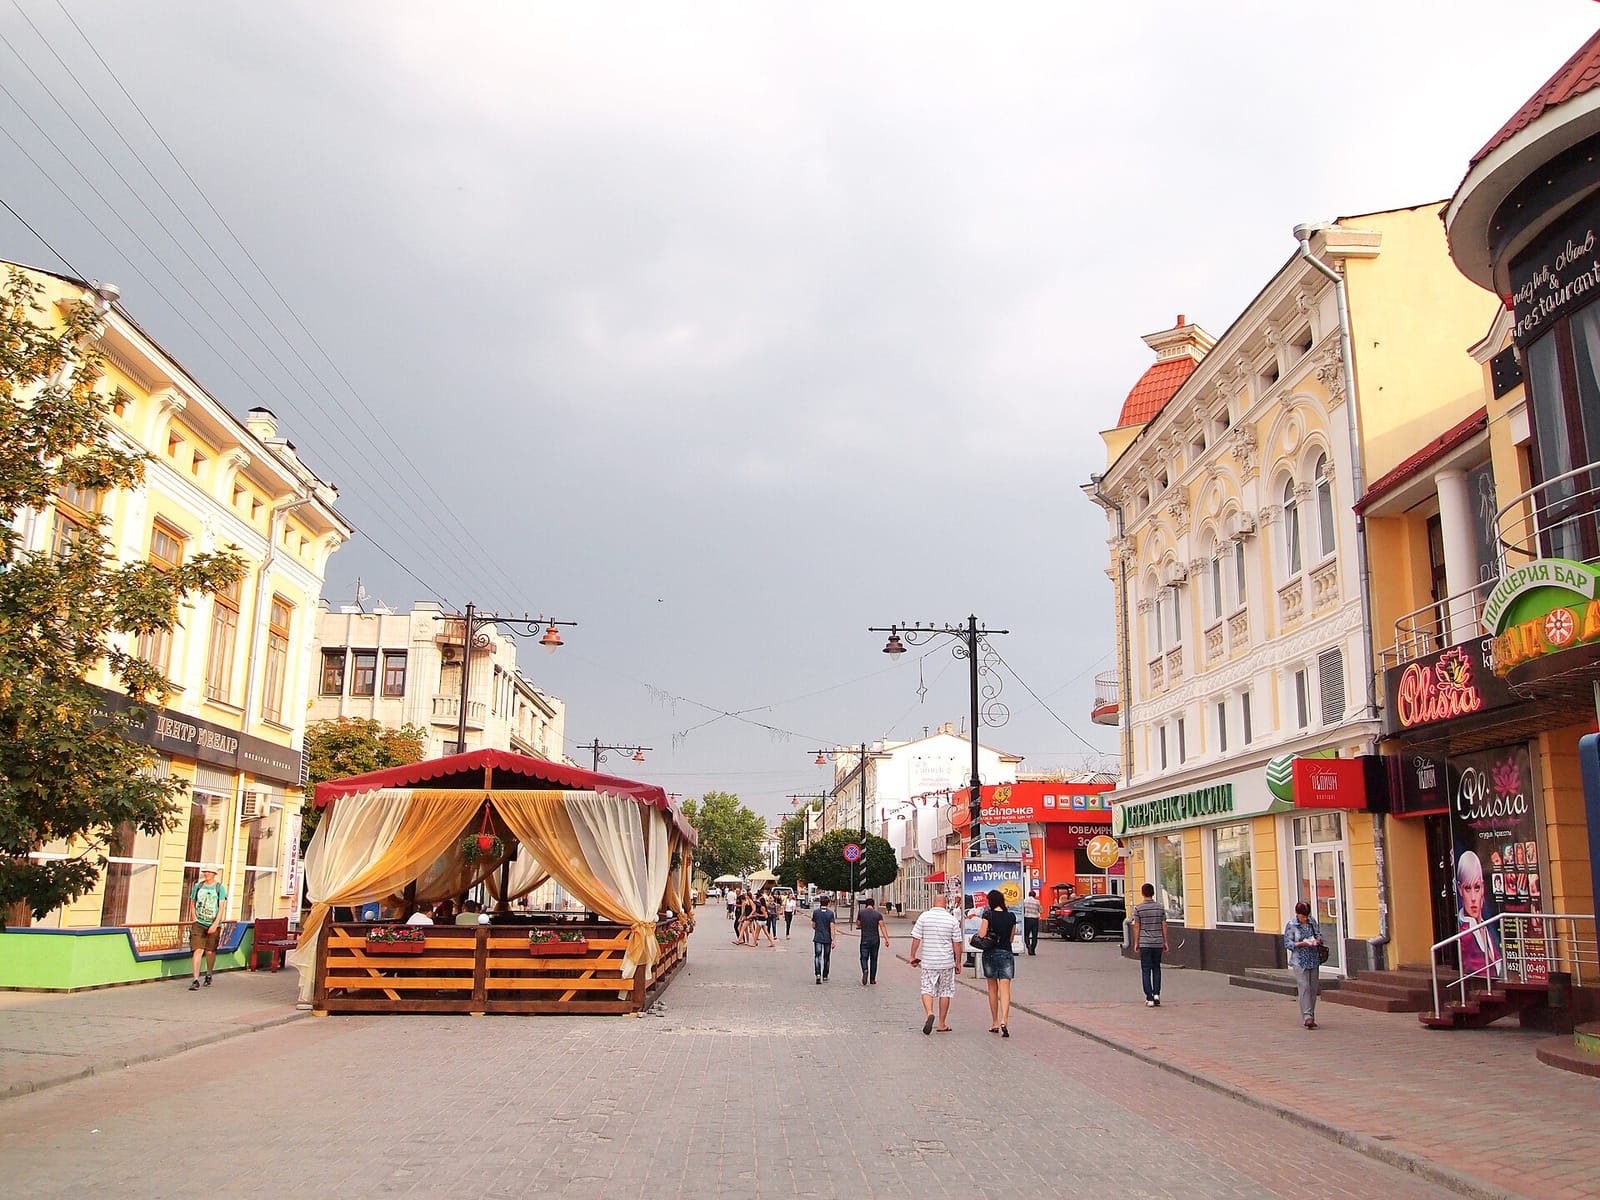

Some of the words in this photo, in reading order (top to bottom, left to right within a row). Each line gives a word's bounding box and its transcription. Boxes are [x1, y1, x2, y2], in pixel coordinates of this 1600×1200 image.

[1485, 564, 1549, 627] ПИЦЦЕРИЯ
[1554, 566, 1588, 588] БАР
[155, 715, 197, 742] ЦЕНТР
[1127, 795, 1181, 829] СБЕРБАНК
[1180, 783, 1234, 820] РОССИИ
[1090, 842, 1111, 855] 24
[967, 863, 993, 873] НАБОР
[984, 871, 1019, 881] ТУРИСТА!
